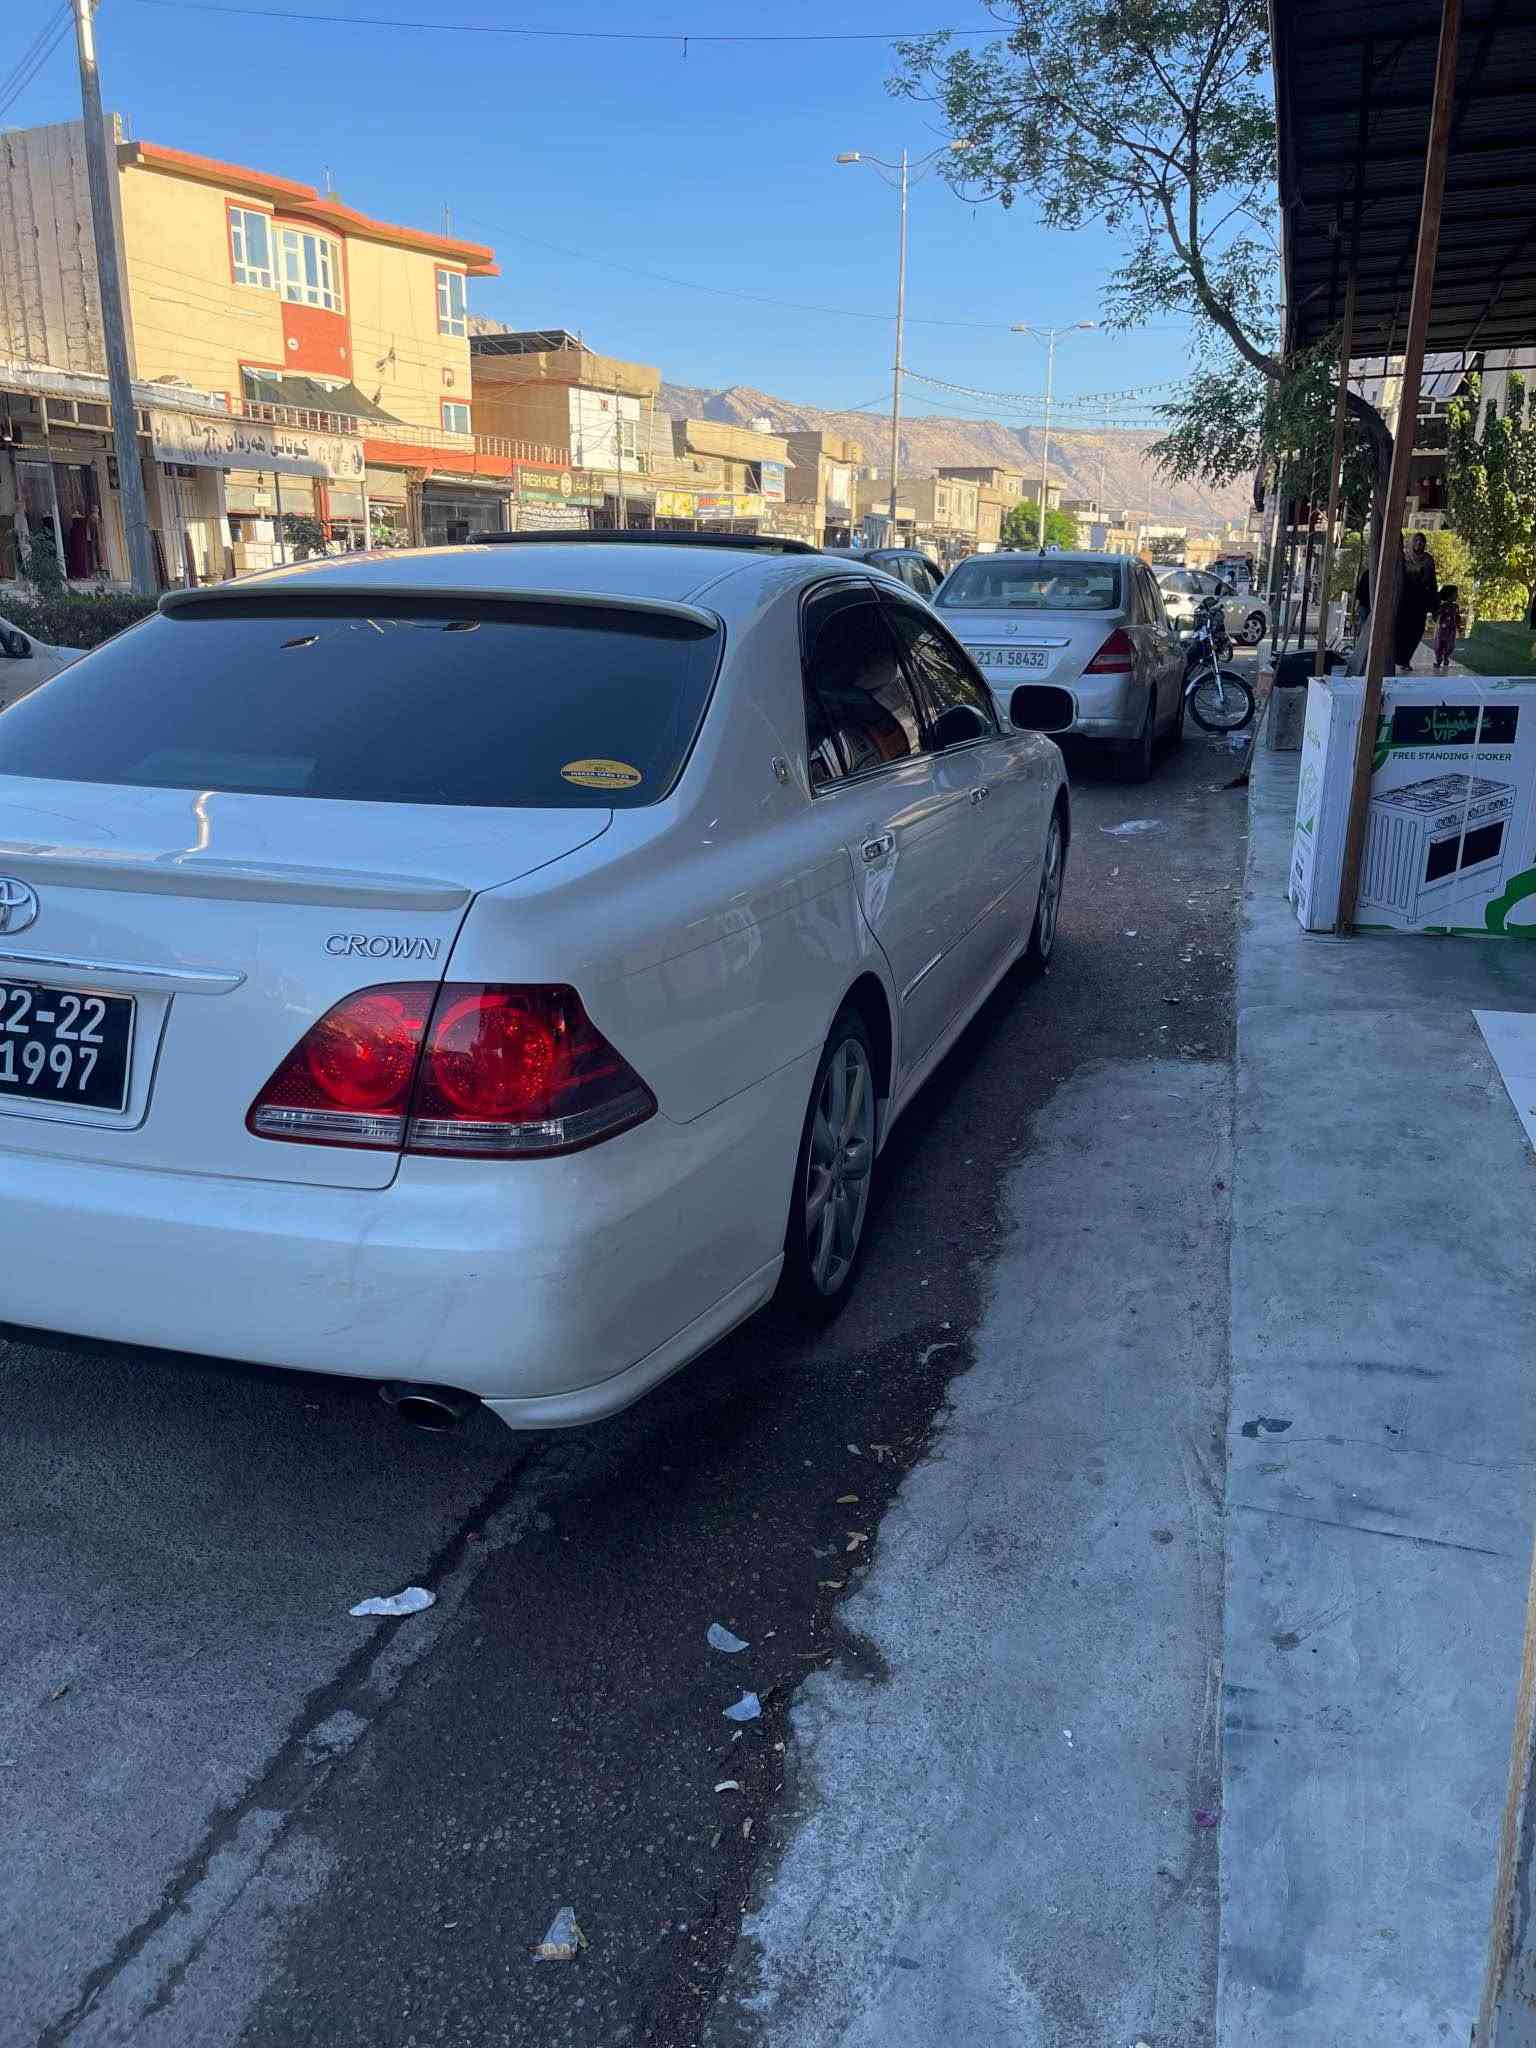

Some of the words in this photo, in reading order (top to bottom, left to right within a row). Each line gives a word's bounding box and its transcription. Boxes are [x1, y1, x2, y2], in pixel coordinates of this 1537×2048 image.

[522, 472, 542, 487] FRESH
[976, 651, 991, 665] 21
[1007, 652, 1045, 667] 58432
[1433, 728, 1458, 741] VIP
[1392, 751, 1417, 761] FREE
[1418, 751, 1470, 761] STANDING
[1470, 752, 1512, 762] OOKER
[323, 933, 440, 961] CROWN
[0, 988, 105, 1044] 2-22
[0, 1039, 98, 1091] 1997
